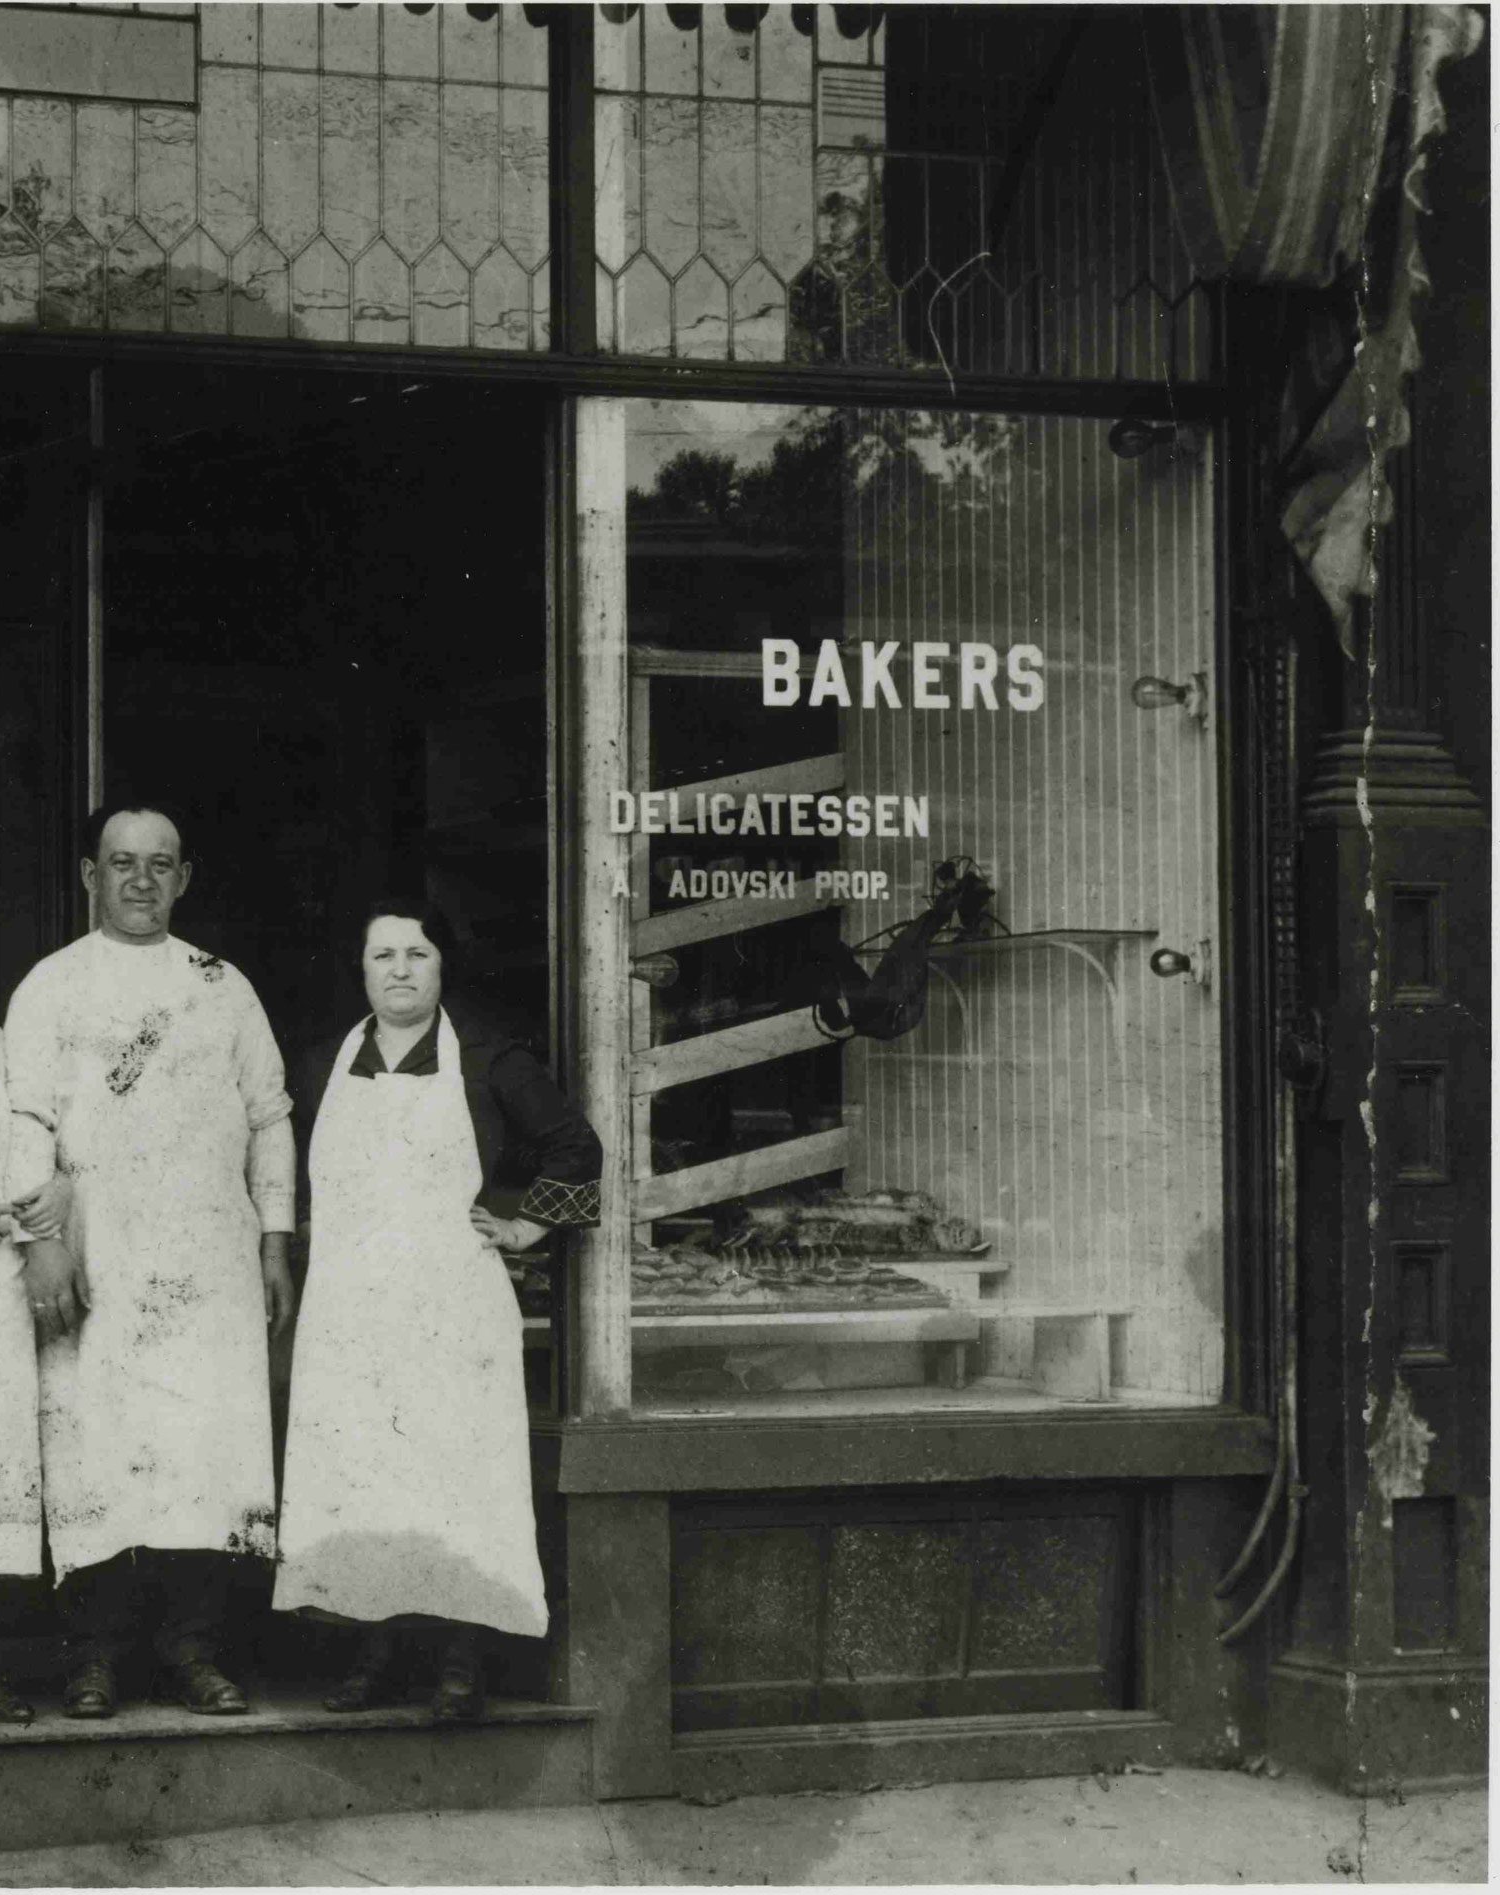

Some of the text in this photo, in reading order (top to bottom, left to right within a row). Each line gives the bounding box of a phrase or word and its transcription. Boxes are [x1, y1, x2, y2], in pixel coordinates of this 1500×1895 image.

[761, 638, 1045, 711] BAKERS
[609, 791, 929, 837] DELICATESSEN
[668, 870, 797, 899] ADOVSKI
[814, 870, 890, 900] PROP.
